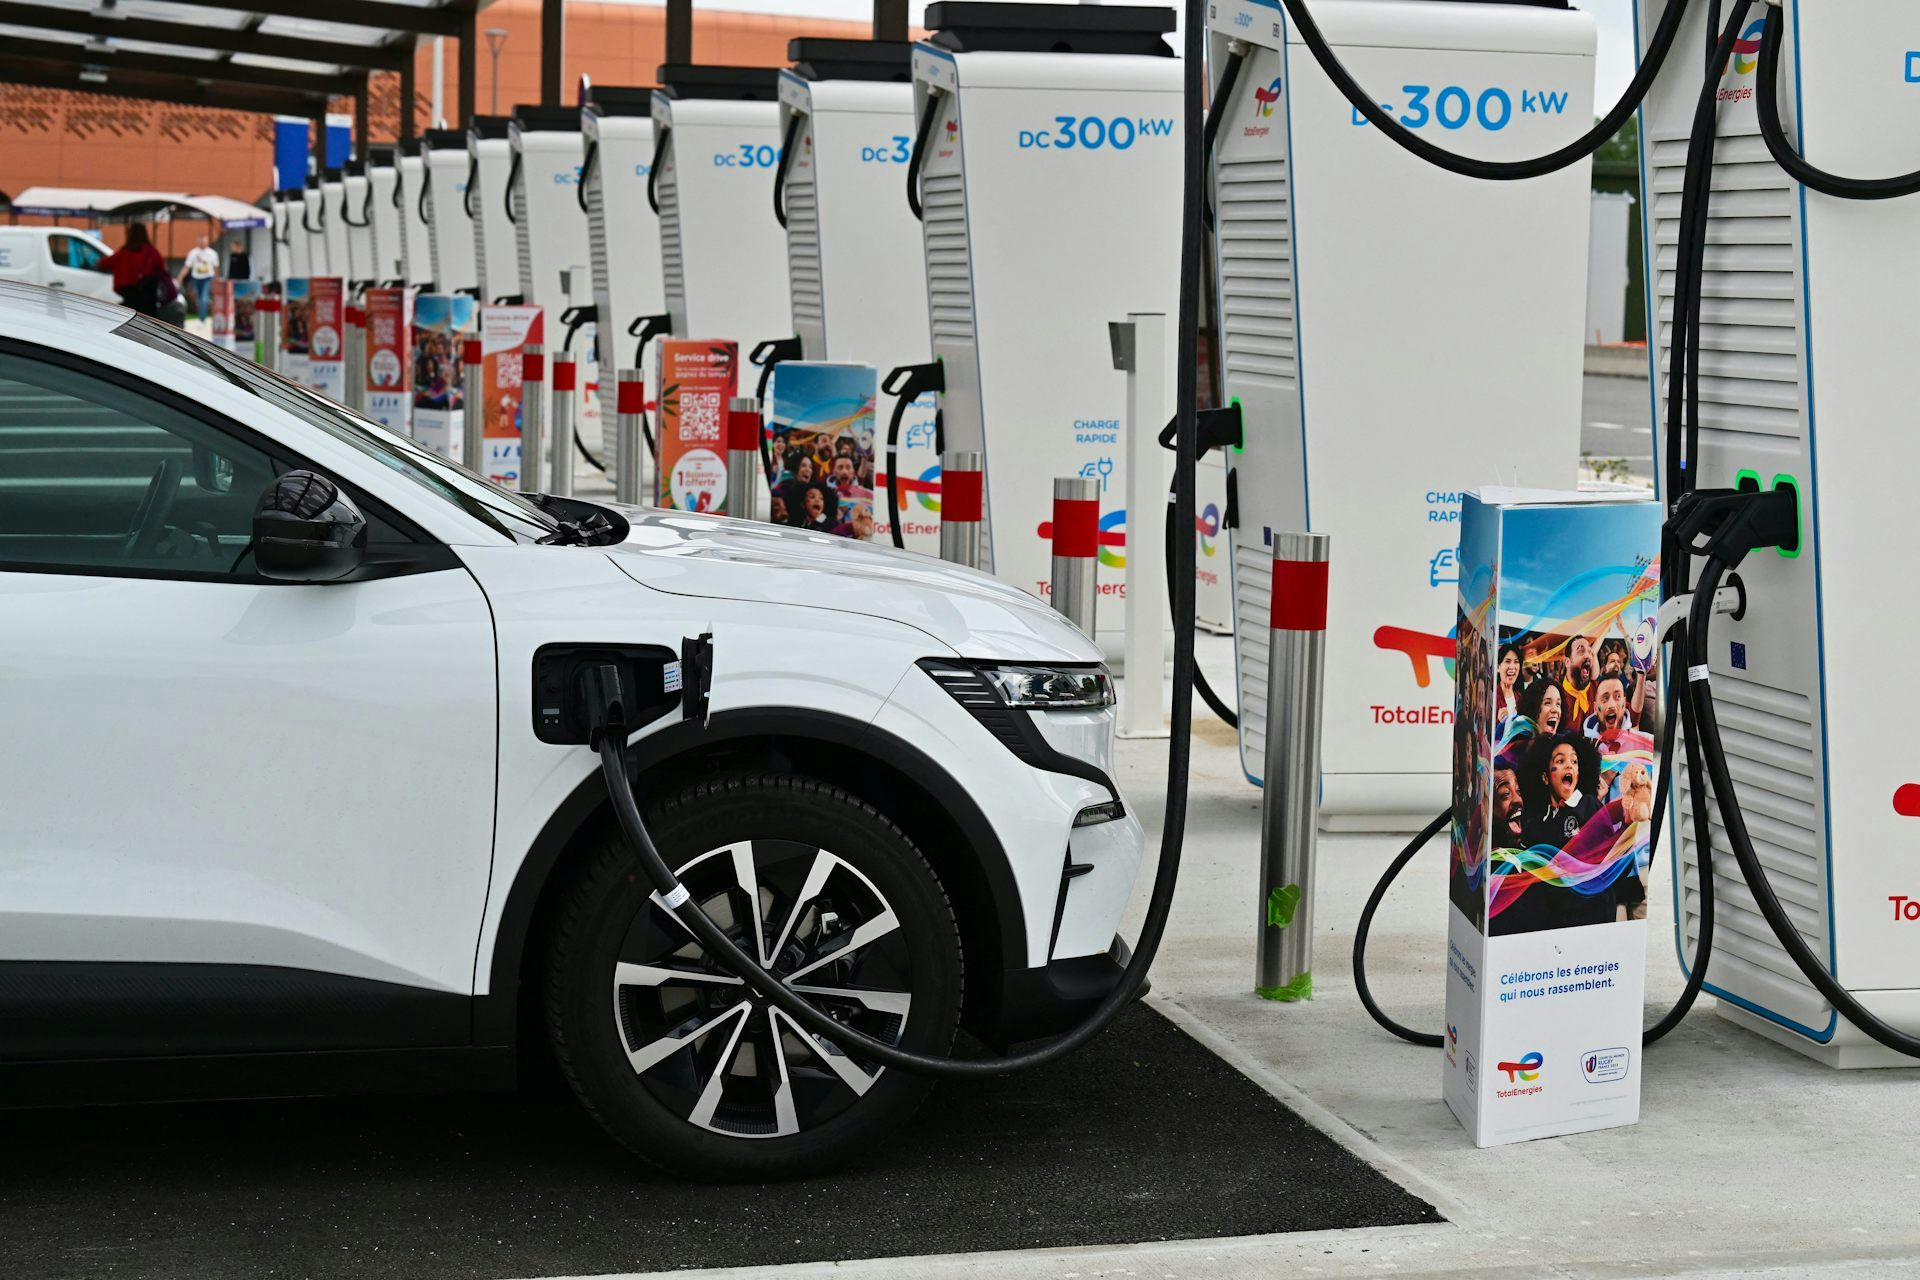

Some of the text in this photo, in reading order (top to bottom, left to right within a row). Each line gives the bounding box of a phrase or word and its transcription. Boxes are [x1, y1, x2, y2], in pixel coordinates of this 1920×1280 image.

[1400, 85, 1511, 131] 300
[1521, 89, 1568, 114] kW
[1019, 116, 1174, 150] DC 300 kW
[713, 144, 783, 168] DC 30
[862, 147, 889, 162] DC
[1073, 419, 1120, 430] CHARGE
[1076, 433, 1118, 444] RAPIDE
[1429, 510, 1462, 522] RAPI
[1370, 705, 1454, 724] TotalEn
[1500, 961, 1619, 985] Célébrons les énergies
[1500, 977, 1615, 1003] qui nous rassemblent.
[1497, 1086, 1542, 1098] TotalEnergies
